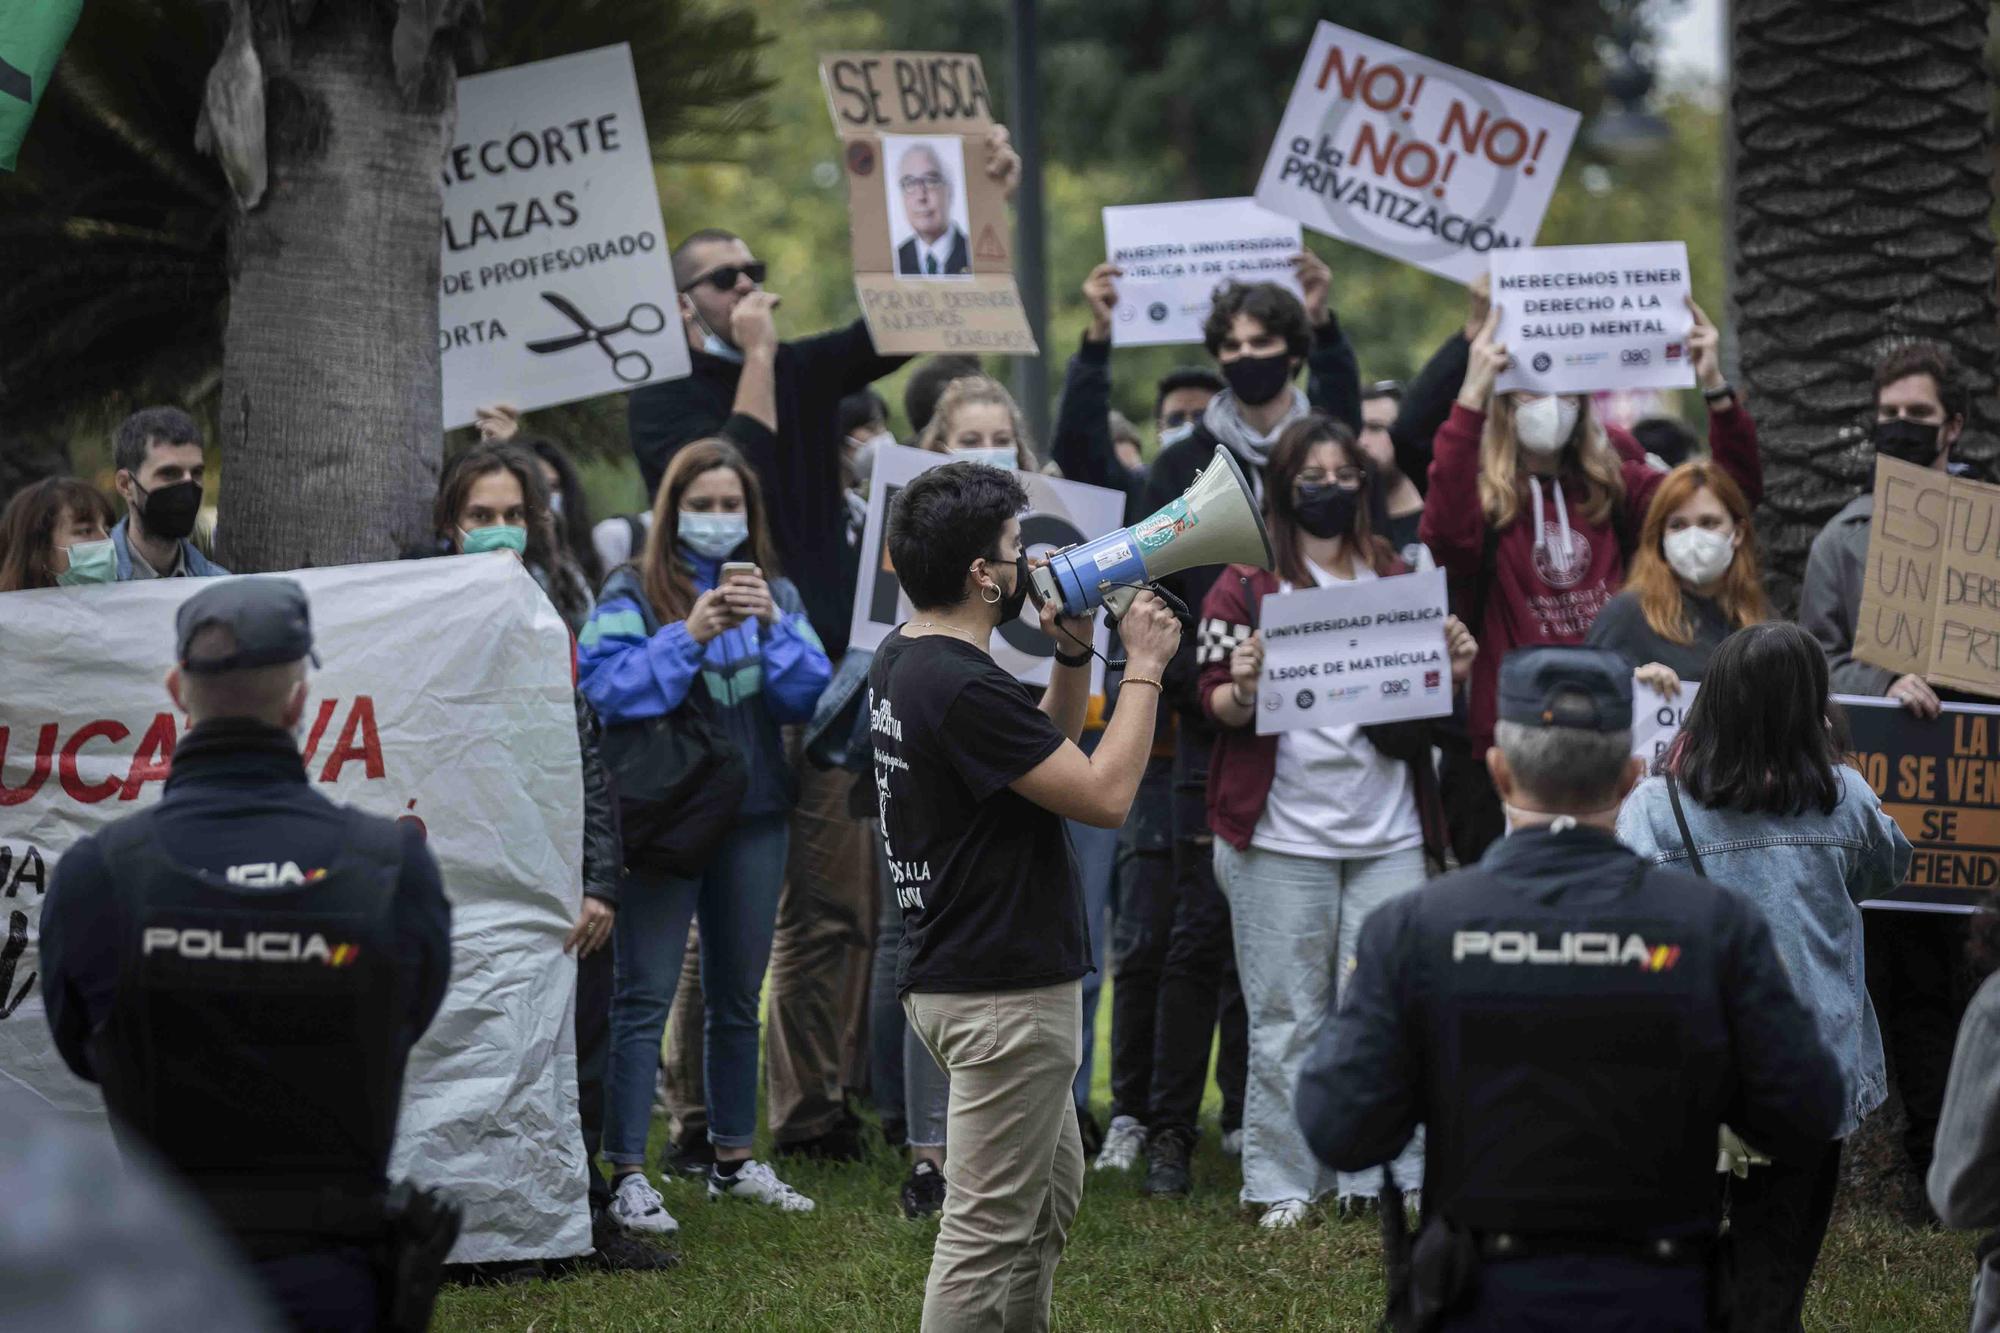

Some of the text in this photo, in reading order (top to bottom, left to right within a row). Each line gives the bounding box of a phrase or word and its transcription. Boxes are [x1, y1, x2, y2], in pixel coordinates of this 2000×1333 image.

[833, 58, 993, 124] SE BUSCA
[1316, 45, 1548, 176] NO! NO!
[443, 113, 622, 186] ECORTE
[1291, 133, 1344, 168] a la
[1350, 120, 1458, 199] NO!
[443, 190, 579, 251] LAZAS
[443, 231, 656, 295] DE PROFESORADO
[1500, 268, 1681, 289] MERECEMOS TENER
[1524, 295, 1662, 314] DERECHO A LA
[438, 318, 507, 350] ORTA
[1521, 319, 1665, 338] SALUD MENTAL
[1881, 476, 2000, 560] ESTU
[1878, 551, 1931, 602] UN
[1265, 607, 1443, 639] UNIVERSIDAD PÚBLICA
[1875, 607, 1923, 659] UN
[1269, 650, 1441, 681] 1.500€ DE MATRÍCULA
[1954, 714, 1988, 758] LA
[1898, 754, 1936, 800] SE
[1920, 809, 1958, 842] SE
[226, 860, 307, 889] ICIA
[1906, 852, 2000, 888] FIEND
[143, 927, 331, 964] POLICIA
[1453, 931, 1651, 964] POLICIA
